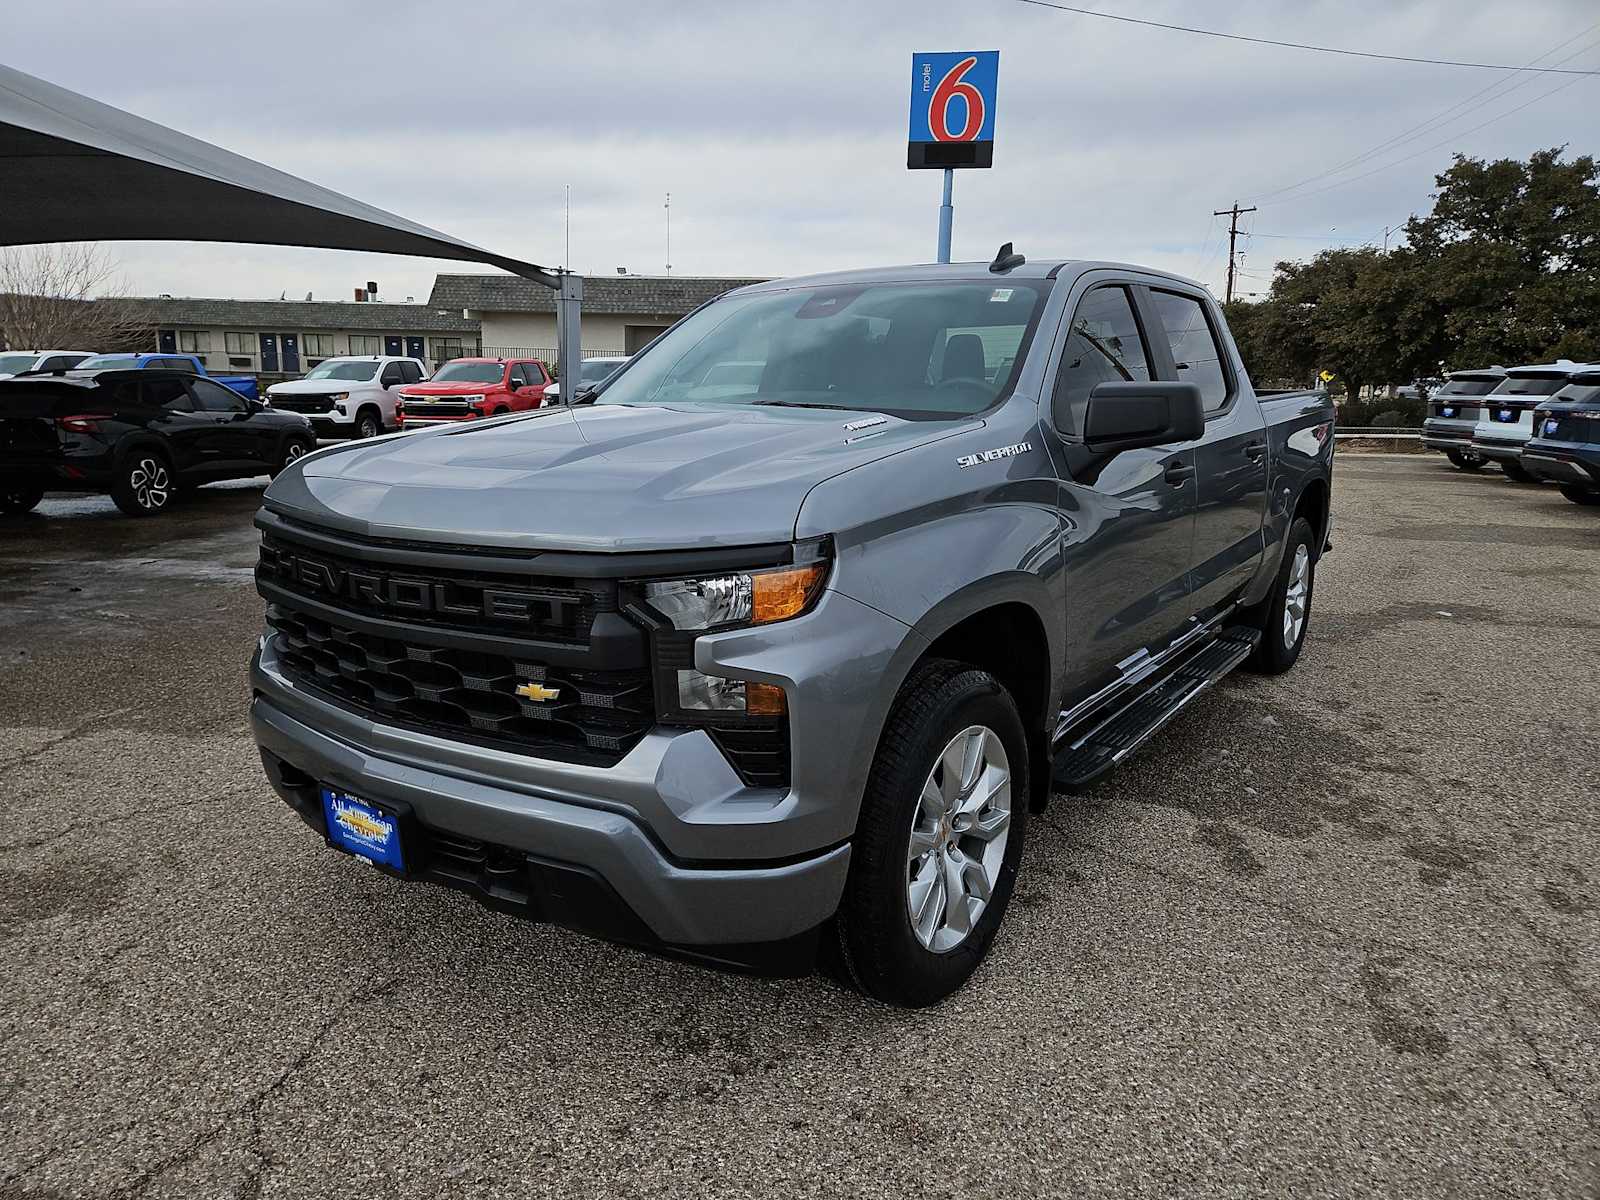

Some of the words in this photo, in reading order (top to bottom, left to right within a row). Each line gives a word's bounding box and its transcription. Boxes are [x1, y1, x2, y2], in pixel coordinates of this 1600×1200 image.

[922, 63, 931, 92] motel
[928, 56, 985, 141] 6
[956, 441, 1032, 469] SILVERADO
[259, 545, 584, 621] CHEVROLET
[340, 817, 388, 845] Chevrolet
